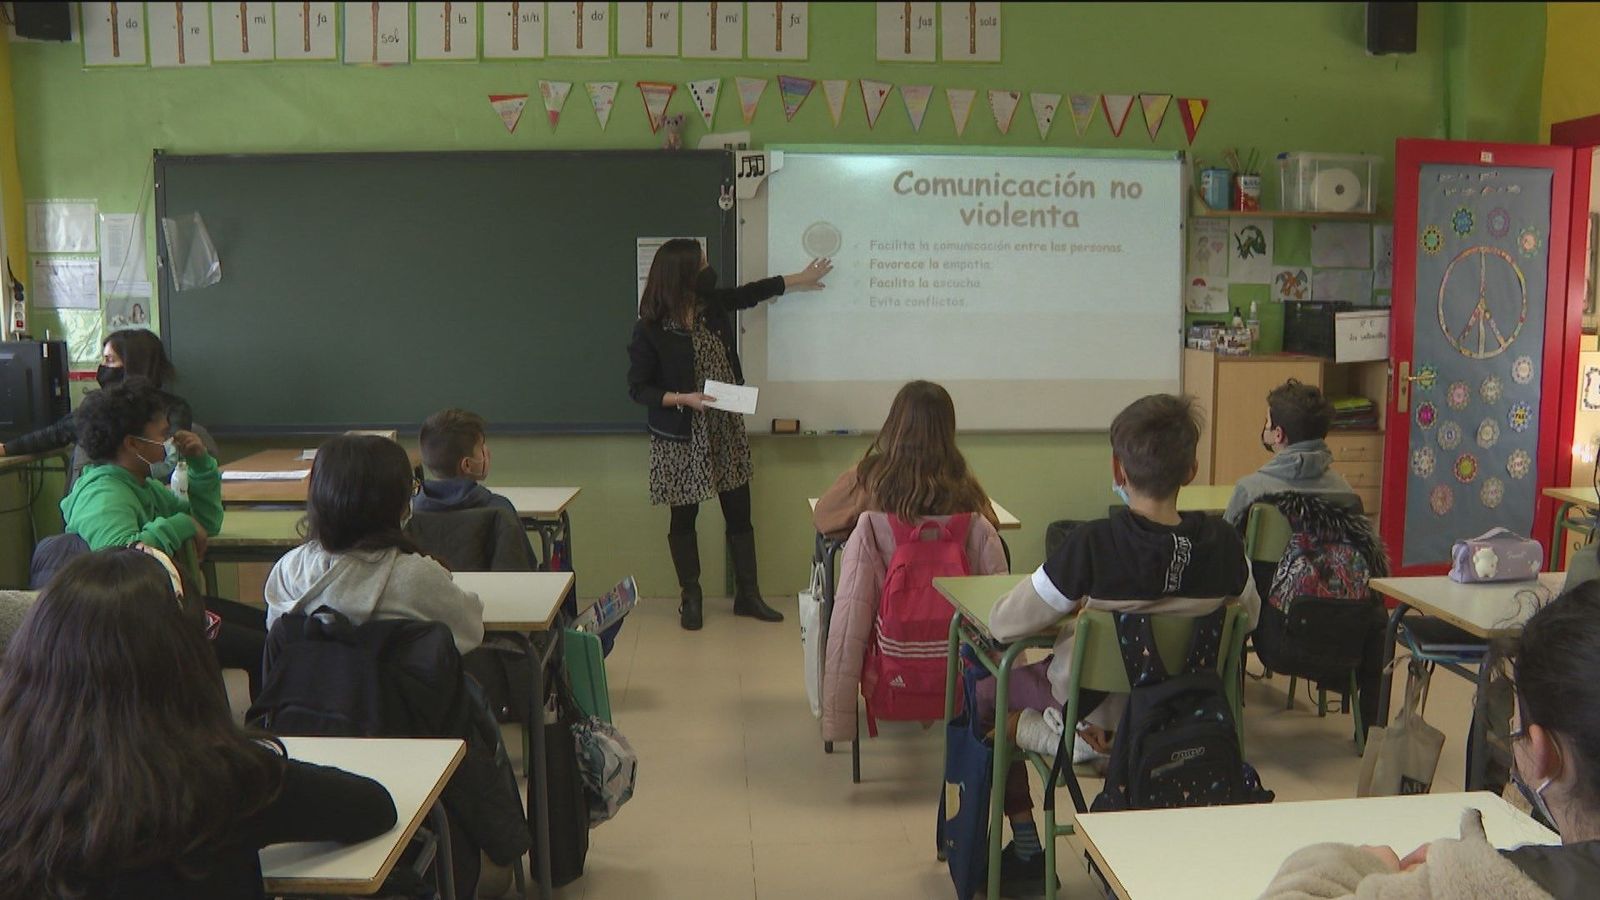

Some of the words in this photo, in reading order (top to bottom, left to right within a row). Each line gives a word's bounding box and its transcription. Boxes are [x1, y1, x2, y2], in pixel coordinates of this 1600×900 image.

[125, 18, 138, 29] do
[254, 15, 267, 25] mi
[316, 13, 328, 28] fa
[458, 15, 468, 25] la
[190, 26, 200, 35] re
[893, 170, 1096, 199] Comunicación
[1110, 179, 1143, 200] no
[959, 201, 1080, 228] violenta
[869, 240, 916, 251] Facilita
[919, 240, 930, 251] la
[1014, 242, 1048, 252] entre
[1050, 242, 1067, 252] las
[869, 258, 925, 270] Favorece
[928, 258, 940, 270] la
[869, 277, 915, 289] Facilita
[918, 277, 929, 289] la
[869, 296, 901, 308] Evita
